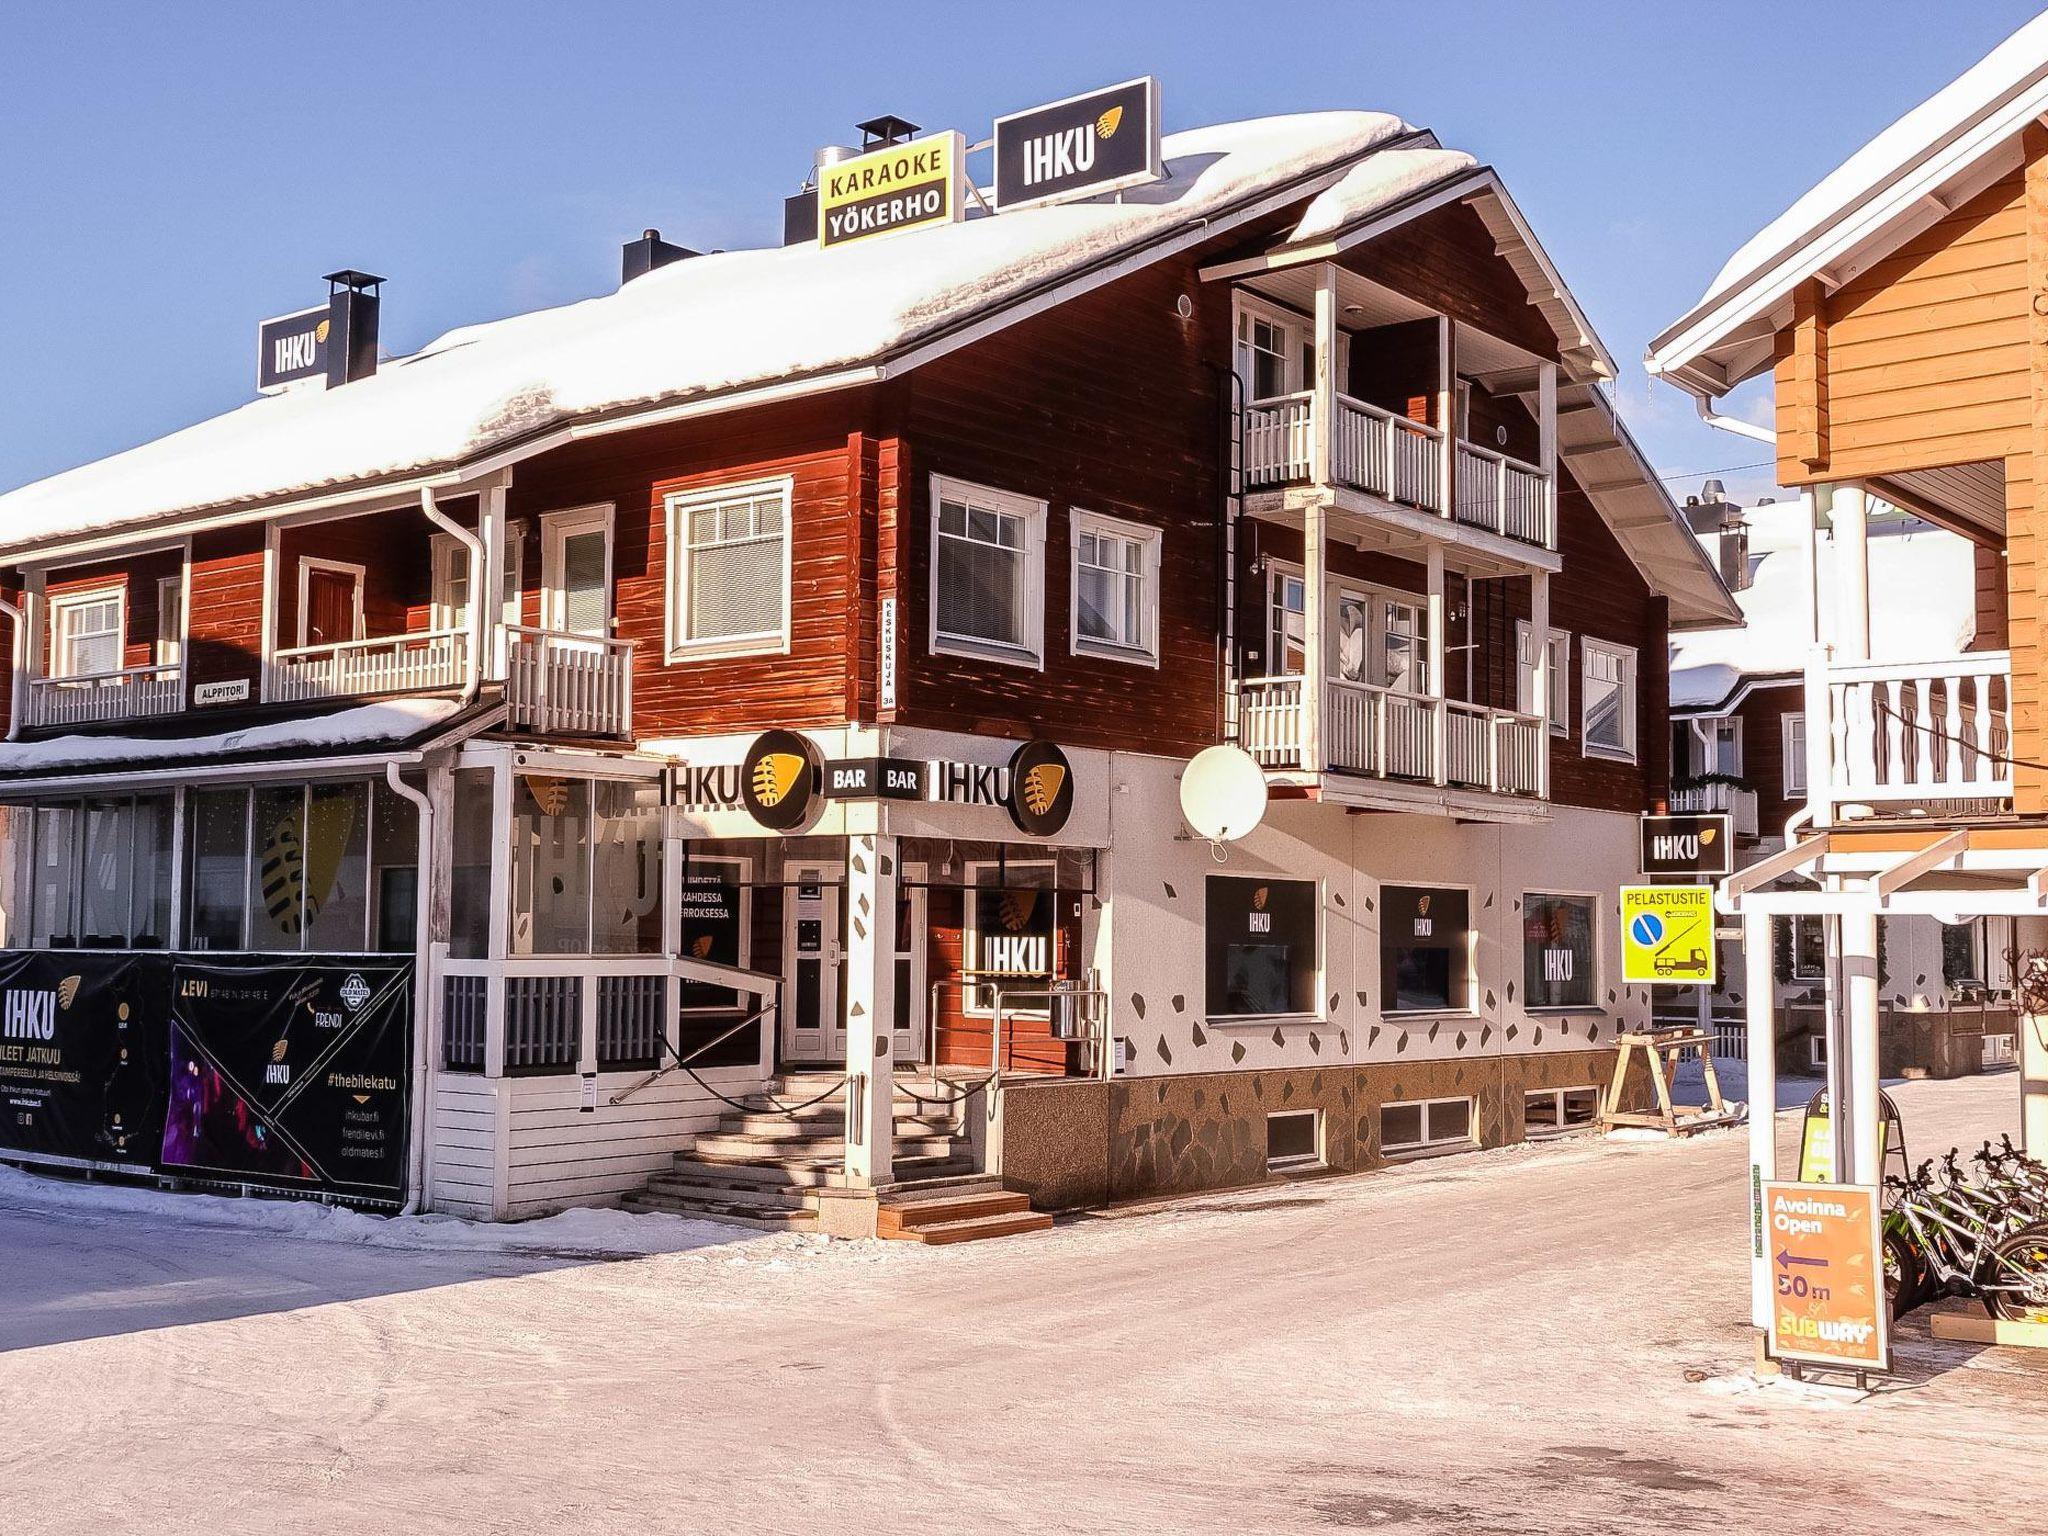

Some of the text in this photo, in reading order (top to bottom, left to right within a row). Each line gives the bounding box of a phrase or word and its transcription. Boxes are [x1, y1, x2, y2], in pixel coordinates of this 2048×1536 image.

[1024, 123, 1095, 186] IHKU
[830, 149, 941, 198] KARAOKE
[829, 188, 941, 238] YÖKERHO
[275, 330, 316, 374] IHKU
[202, 684, 245, 700] ALPPITORI
[883, 697, 894, 705] 3A
[659, 765, 741, 806] IHKU
[833, 769, 866, 789] BAR
[887, 769, 917, 790] BAR
[937, 760, 1010, 807] IHKU
[1653, 834, 1699, 860] IHKU
[1627, 892, 1706, 905] PELASTUSTIE
[1249, 912, 1271, 933] IHKU
[1414, 917, 1432, 937] IHKU
[985, 936, 1046, 979] IHKU
[1544, 949, 1573, 981] IHKU
[181, 979, 208, 998] LEVI
[4, 989, 57, 1040] IHKU
[315, 1012, 342, 1028] FRENDI
[26, 1046, 61, 1065] JATKUU
[266, 1065, 290, 1085] IHKU
[328, 1073, 396, 1090] #thebilekatu
[1774, 1195, 1847, 1218] Avoinna
[1774, 1213, 1823, 1236] Open
[1778, 1273, 1831, 1300] 50 m
[1778, 1314, 1875, 1345] SUBWAY
